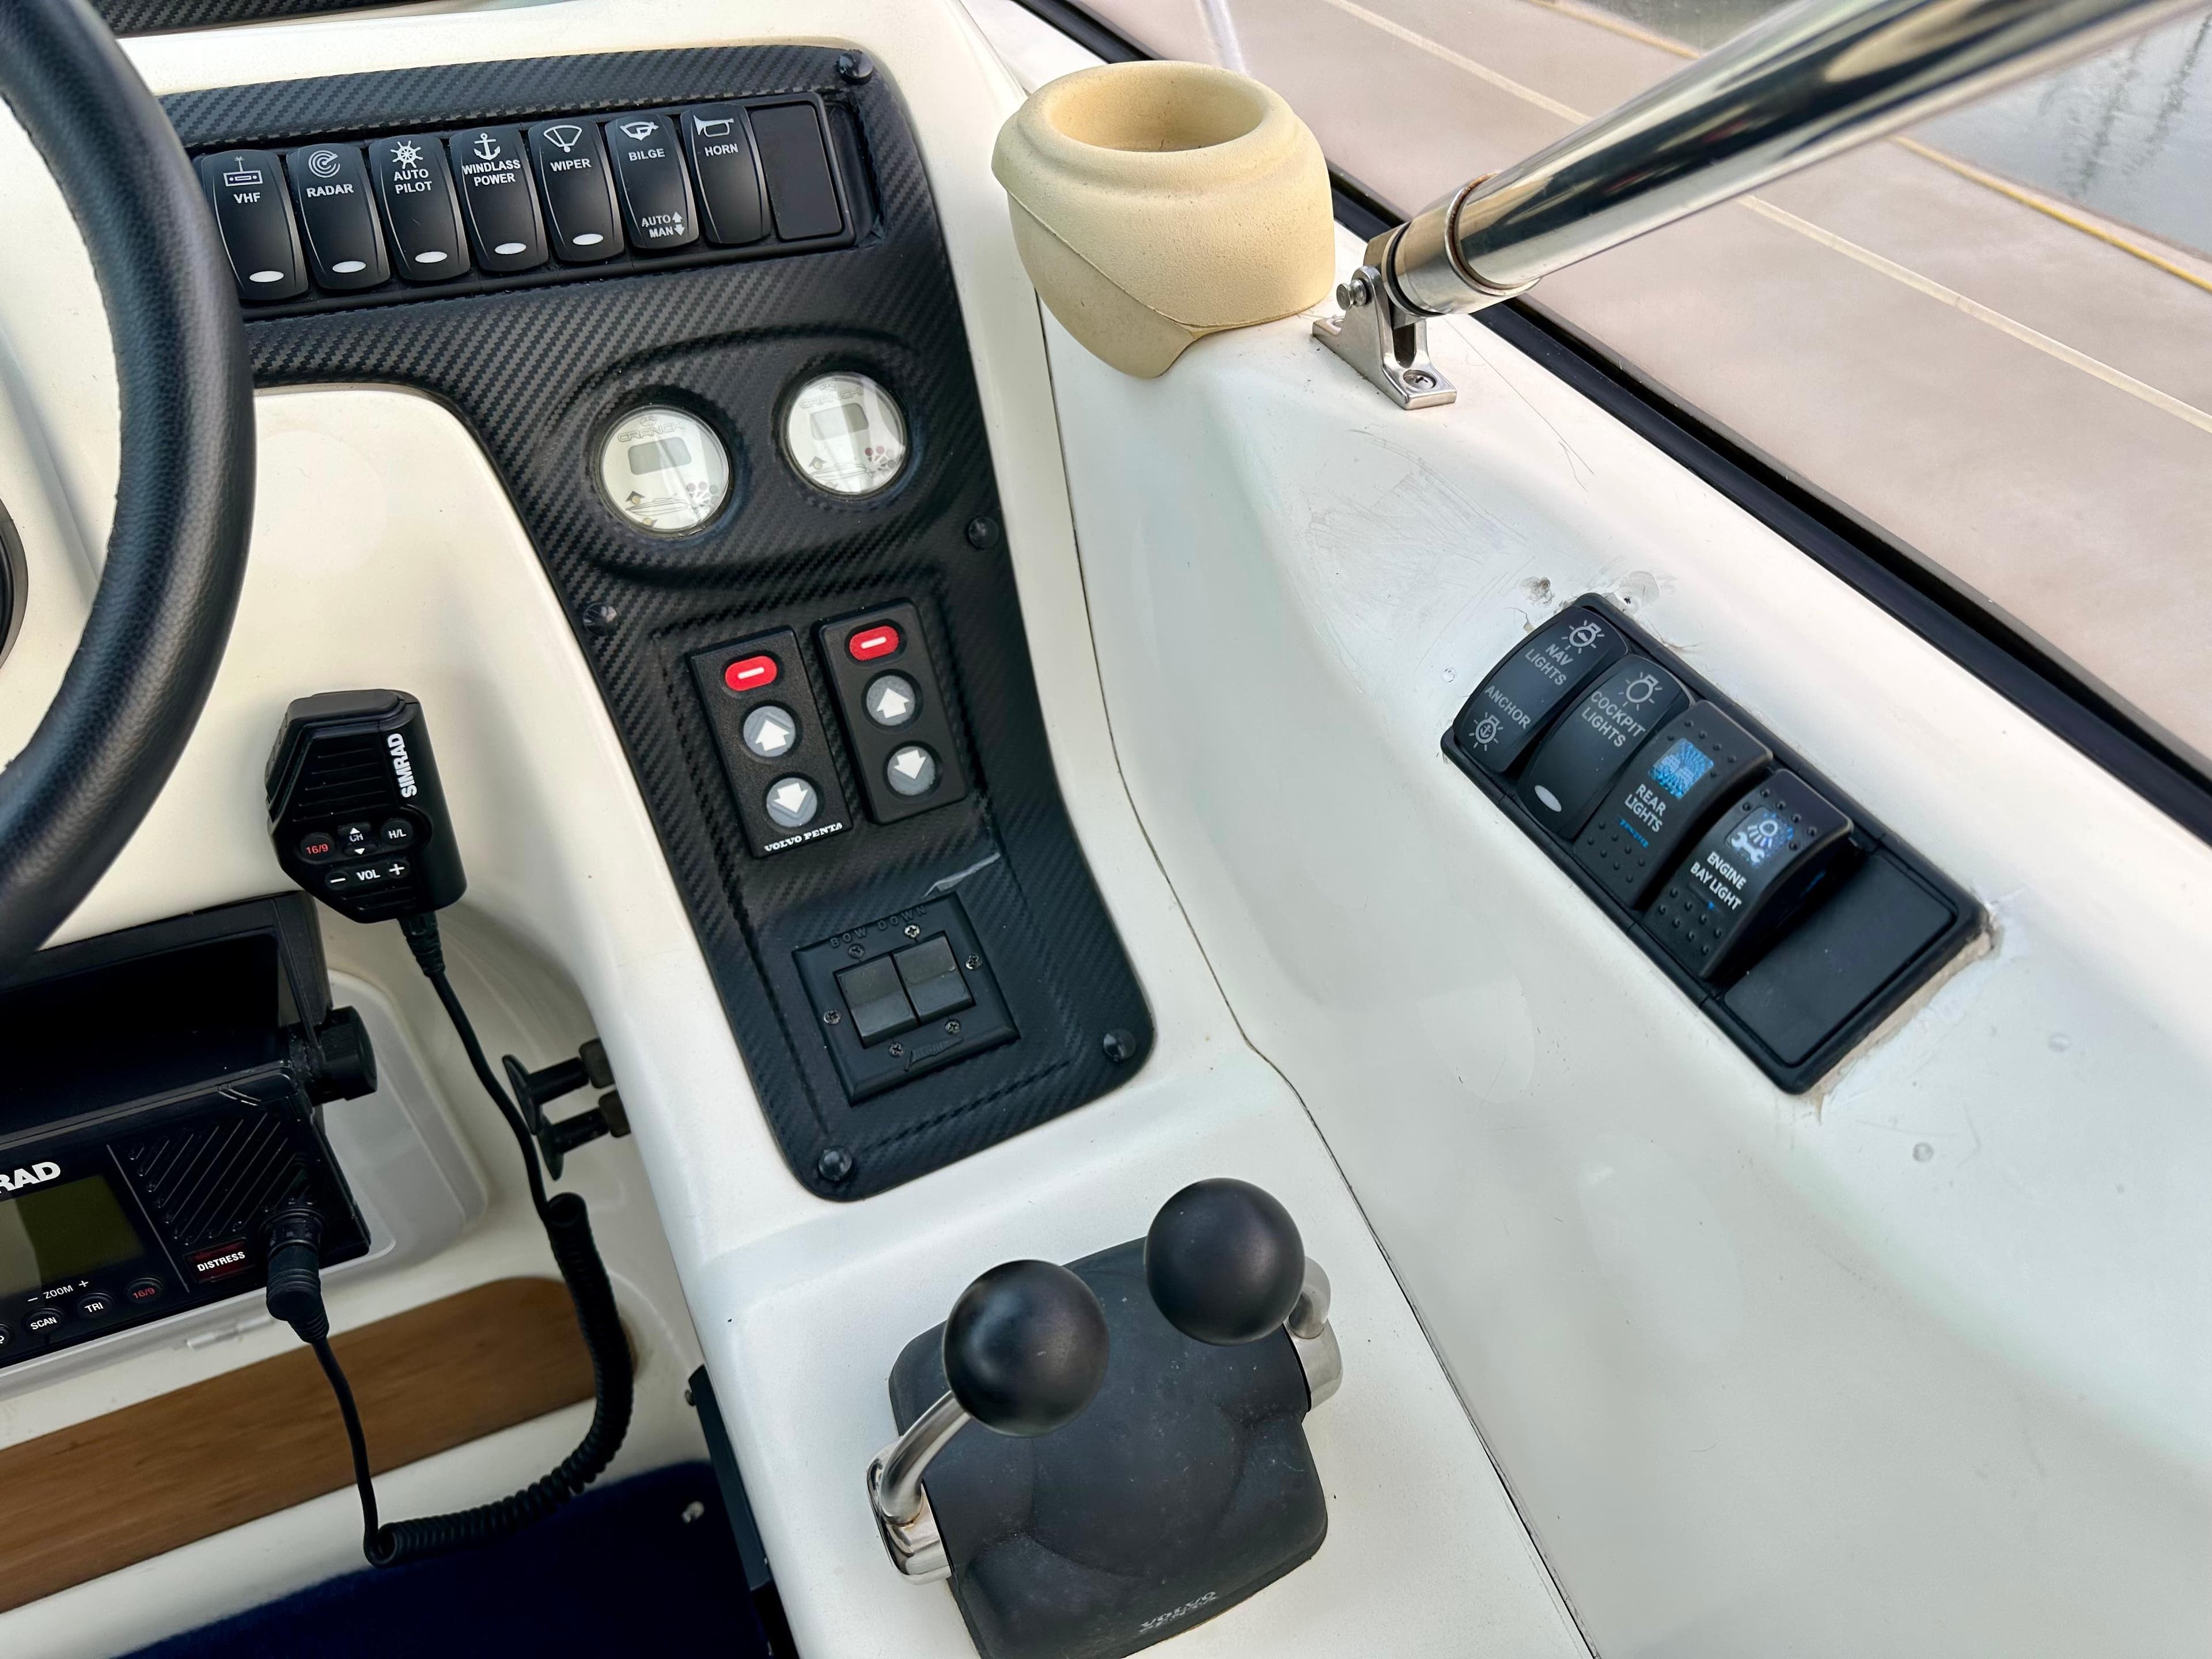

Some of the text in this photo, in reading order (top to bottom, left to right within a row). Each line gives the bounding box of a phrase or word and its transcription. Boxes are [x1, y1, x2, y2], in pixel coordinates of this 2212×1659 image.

[628, 148, 665, 161] BILGE
[704, 144, 738, 156] HORN
[462, 160, 521, 175] WINDLASS
[550, 158, 592, 172] WIPER
[393, 169, 429, 181] AUTO
[474, 173, 516, 186] POWER
[306, 184, 354, 198] RADAR
[395, 181, 433, 194] PILOT
[233, 192, 261, 204] VHF
[641, 214, 671, 228] AUTO
[649, 226, 673, 238] MAN
[1545, 643, 1573, 666] NAV
[1525, 648, 1567, 685] LIGHTS
[1484, 685, 1532, 730] ANCHOR
[1590, 691, 1646, 737] COCKPIT
[1581, 707, 1626, 747] LIGHTS
[387, 733, 417, 798] SIMRAD
[1635, 783, 1666, 816] REAR
[1624, 794, 1662, 832] LIGHTS
[349, 833, 363, 842] CH
[388, 830, 406, 839] H/L
[764, 822, 843, 852] VOLVO PENTA
[306, 843, 328, 855] 16/9
[356, 869, 380, 881] VOL
[1706, 851, 1747, 890] ENGINE
[1690, 862, 1742, 911] BAY LIGHT
[830, 906, 927, 948] BOW DOWN
[197, 1251, 245, 1272] DISTRESS
[43, 1285, 73, 1300] ZOOM
[132, 1286, 155, 1299] 16/9
[85, 1302, 103, 1313] TRI
[30, 1317, 57, 1330] SCAN
